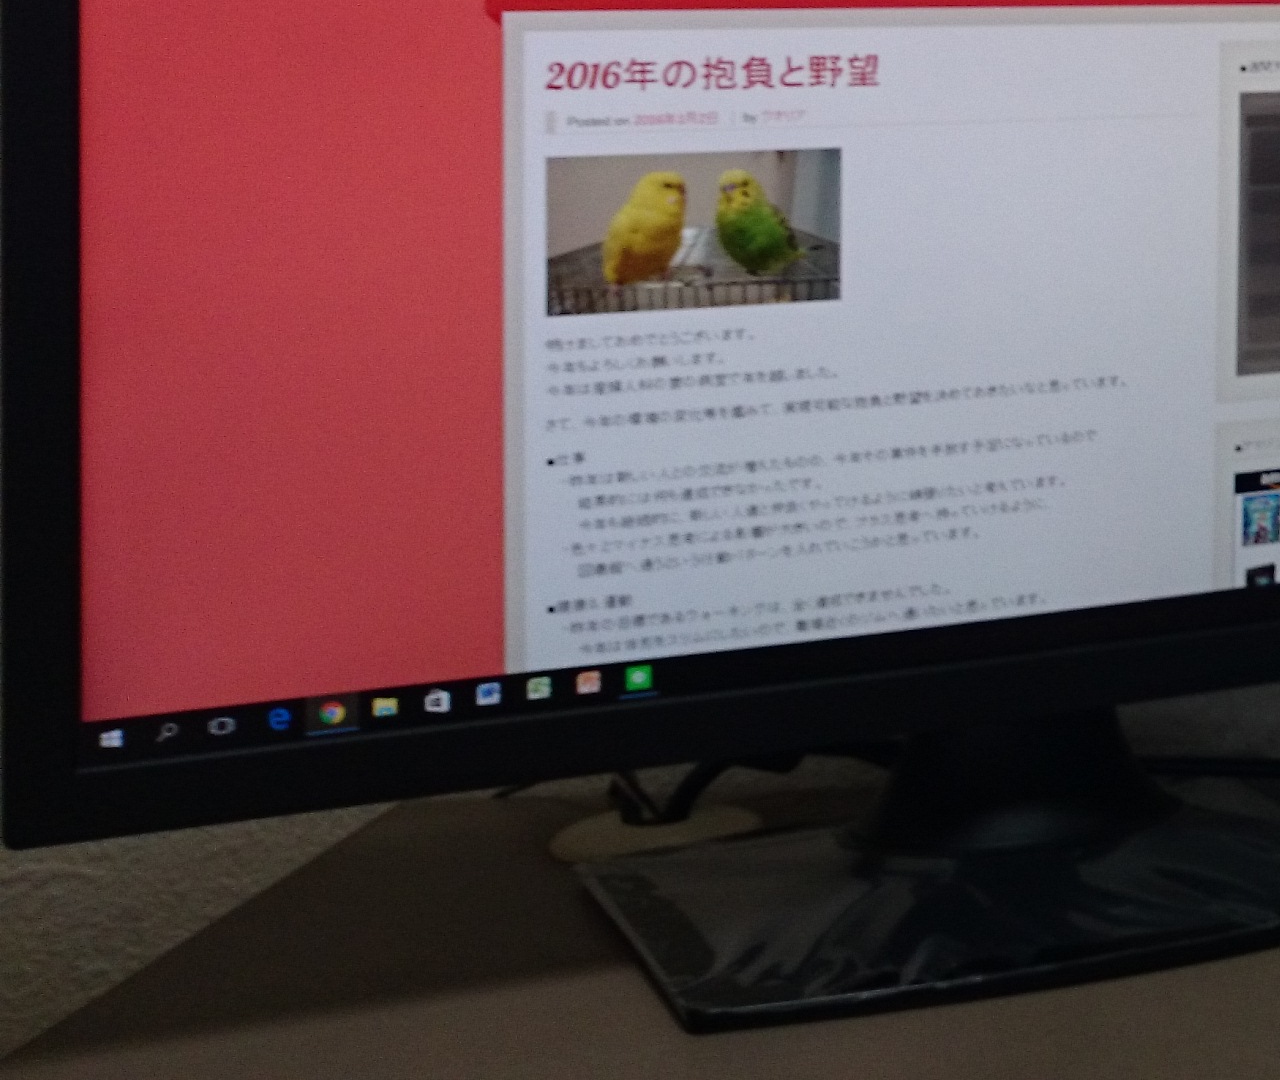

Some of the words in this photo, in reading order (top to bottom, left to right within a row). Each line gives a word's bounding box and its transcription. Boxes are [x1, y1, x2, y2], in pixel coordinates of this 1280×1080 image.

[545, 53, 881, 91] 2016年の抱負と野望
